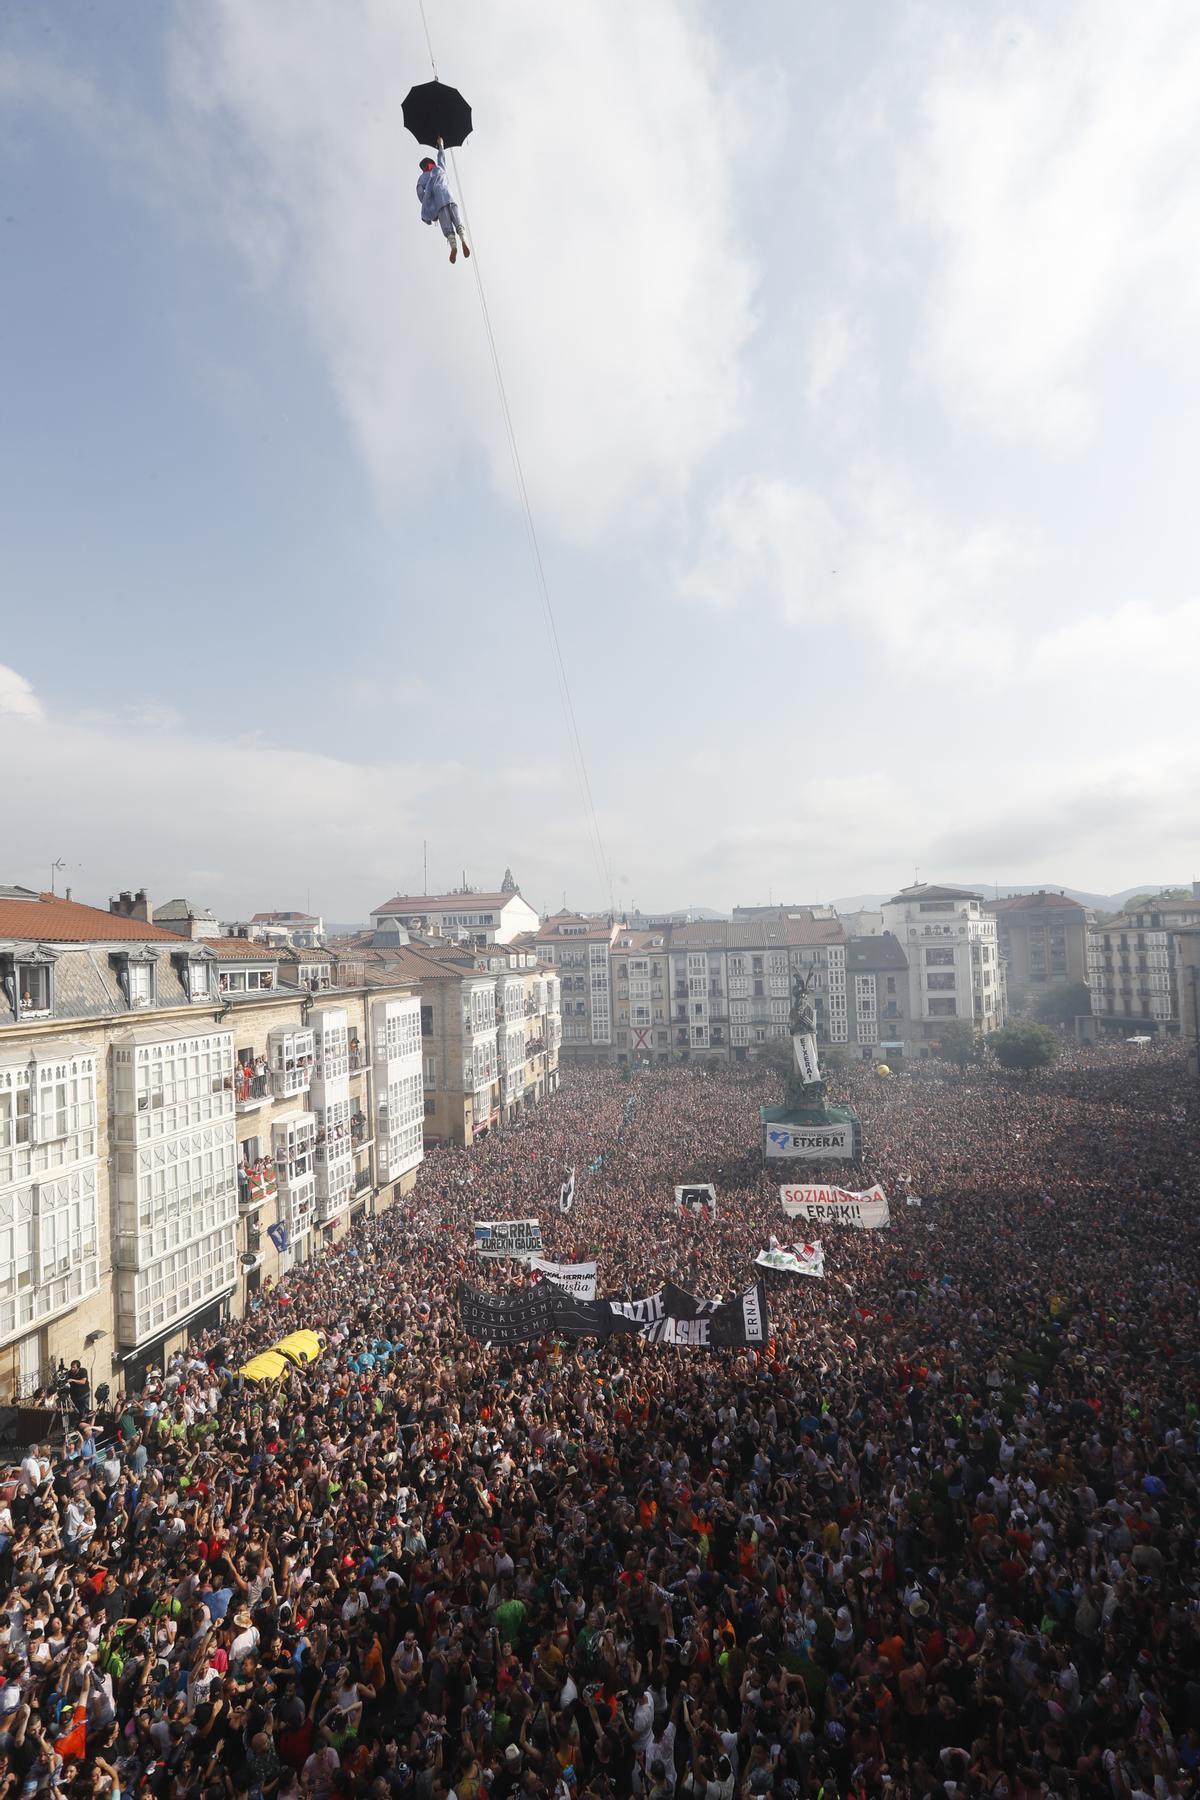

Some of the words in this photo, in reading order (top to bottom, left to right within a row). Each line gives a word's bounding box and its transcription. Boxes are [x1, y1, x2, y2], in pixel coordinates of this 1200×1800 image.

[799, 1037, 813, 1080] ETXERA!
[792, 1136, 844, 1147] ETXERA!
[806, 1204, 861, 1219] ERAIKI!
[481, 1238, 513, 1250] ZUREKIN
[515, 1237, 541, 1249] GAUDE
